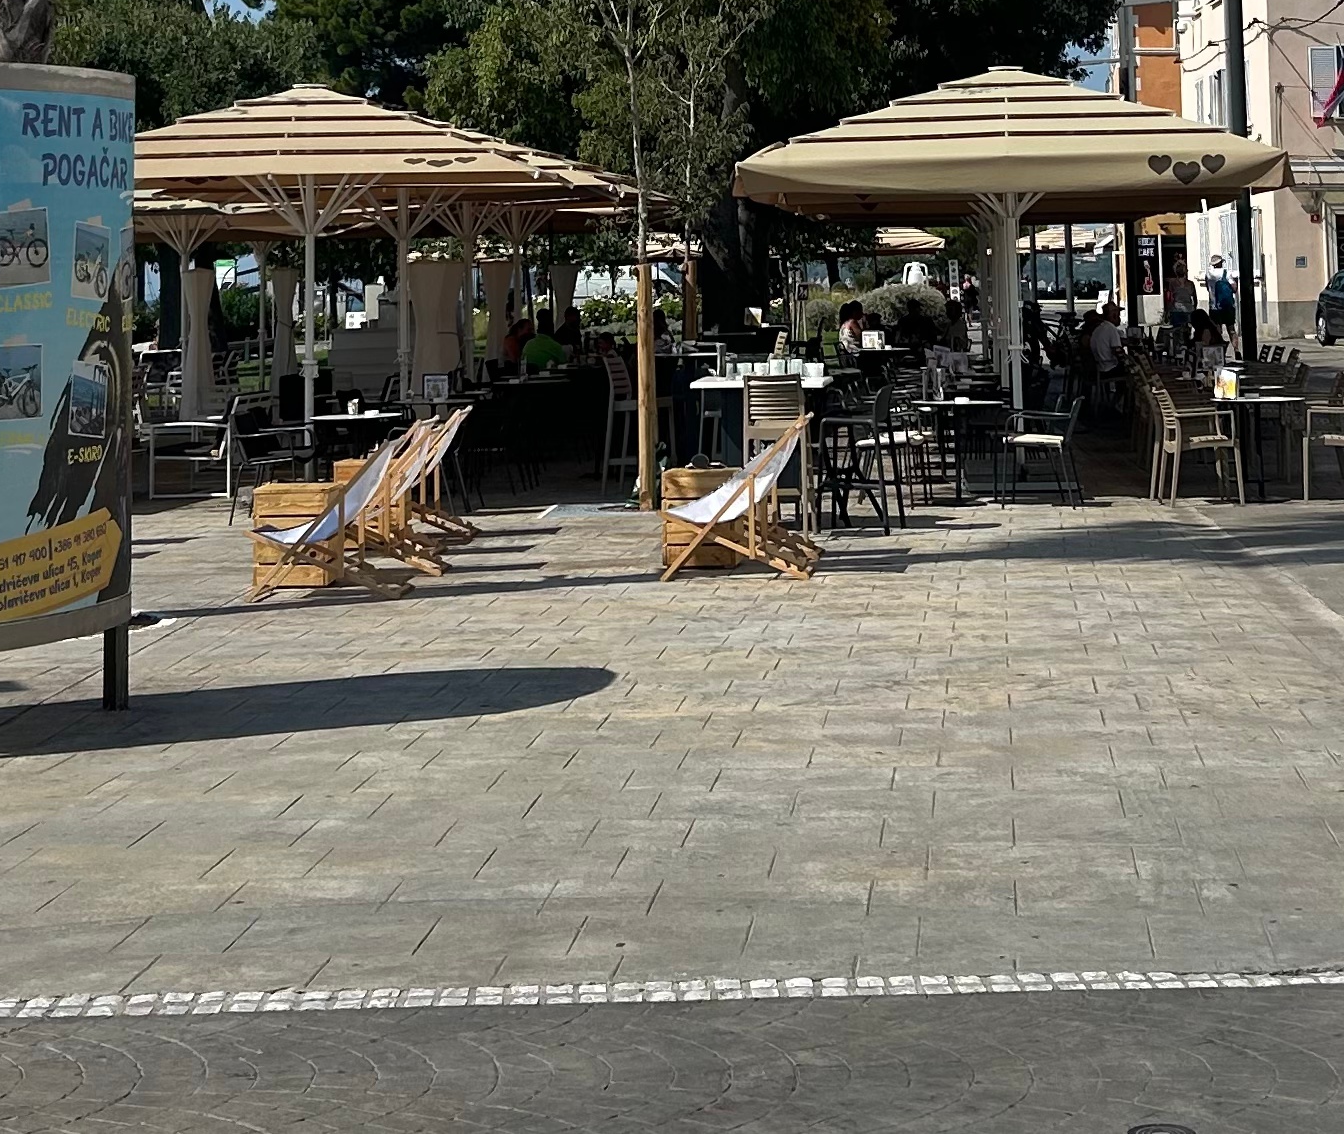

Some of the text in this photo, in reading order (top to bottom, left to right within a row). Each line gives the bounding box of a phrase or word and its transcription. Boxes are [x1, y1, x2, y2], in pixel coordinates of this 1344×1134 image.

[22, 103, 133, 143] RENT A BIKE
[41, 146, 128, 191] POGAČAR
[66, 308, 111, 333] ELECTRIC
[67, 445, 103, 465] E-SKIRO
[28, 546, 47, 562] 400
[54, 537, 72, 554] +386
[42, 563, 65, 580] ulica
[82, 547, 102, 566] Koper
[49, 578, 70, 595] ulica
[81, 565, 102, 583] Koper
